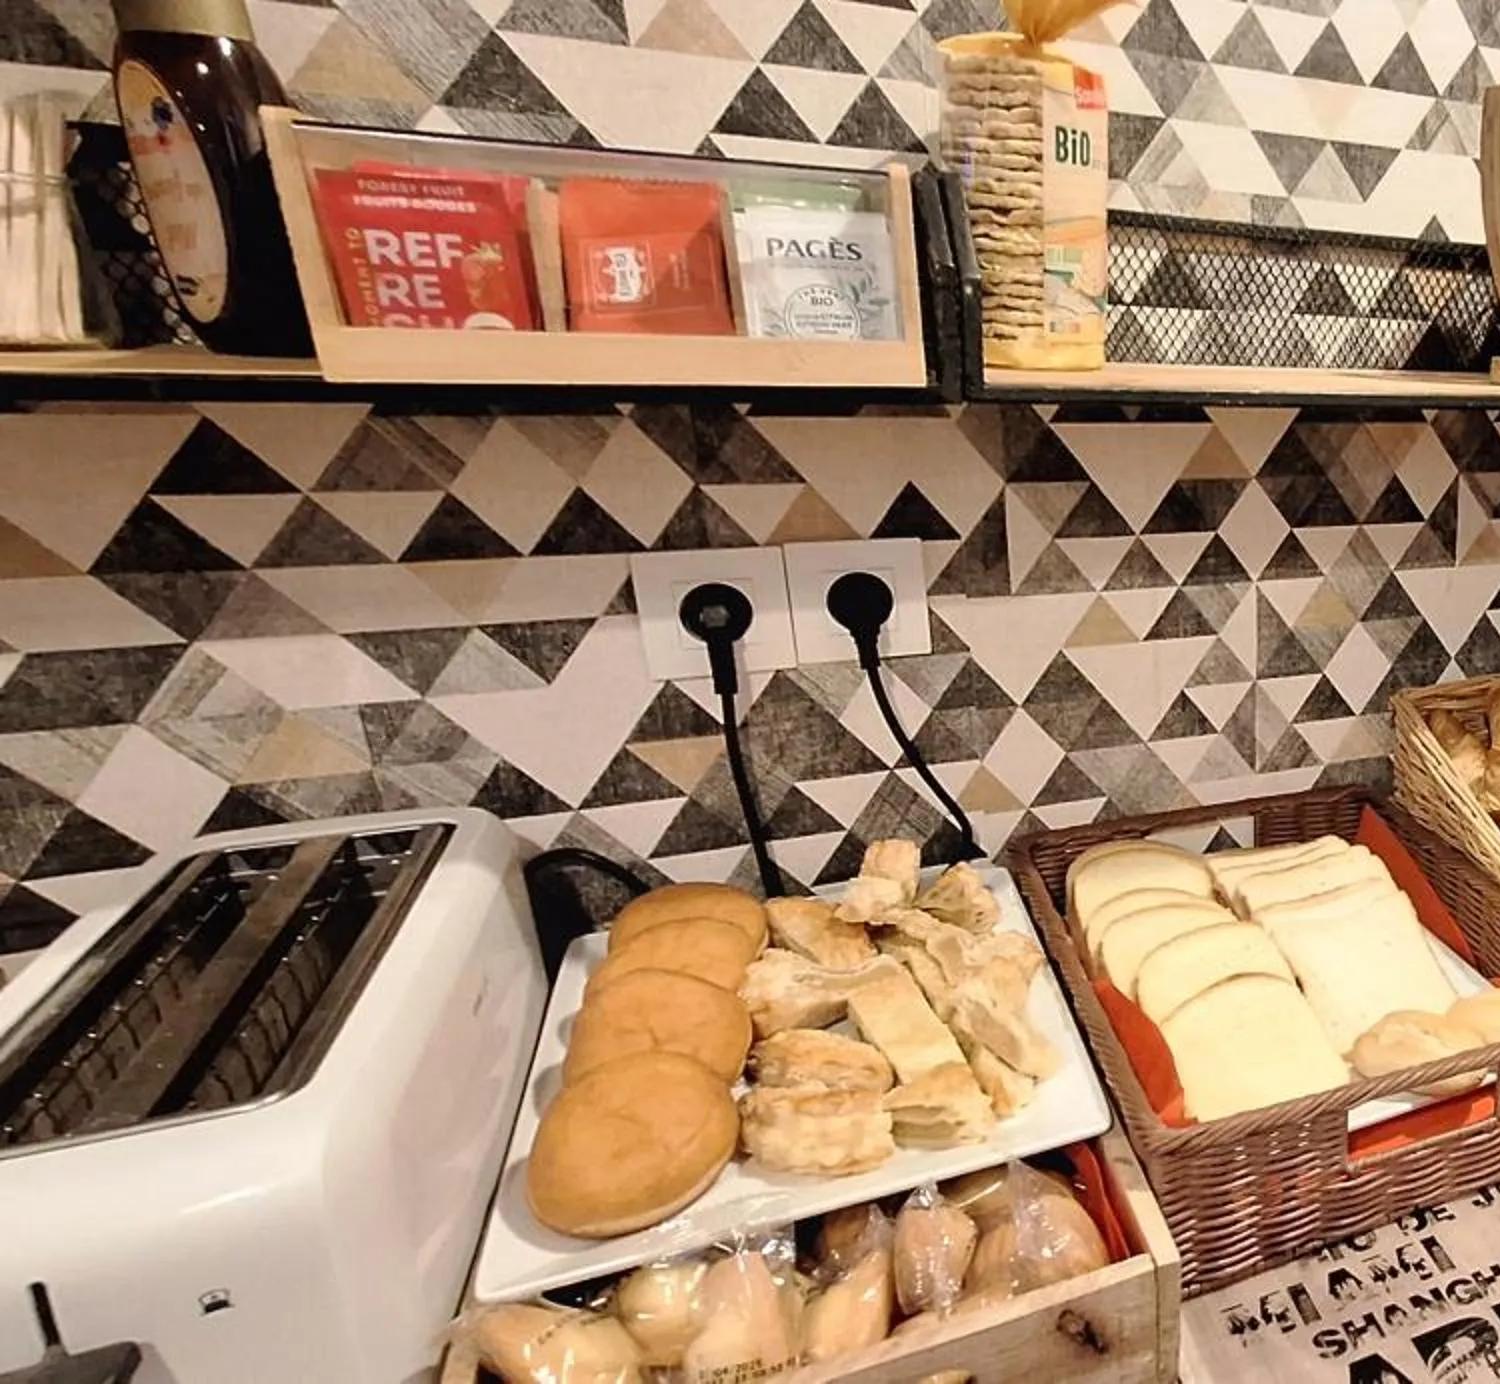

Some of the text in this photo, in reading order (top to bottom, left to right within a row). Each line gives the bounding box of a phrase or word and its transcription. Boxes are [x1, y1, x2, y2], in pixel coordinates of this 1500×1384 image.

[363, 229, 464, 270] REF
[766, 236, 863, 262] PAGÈS
[374, 272, 446, 309] RE
